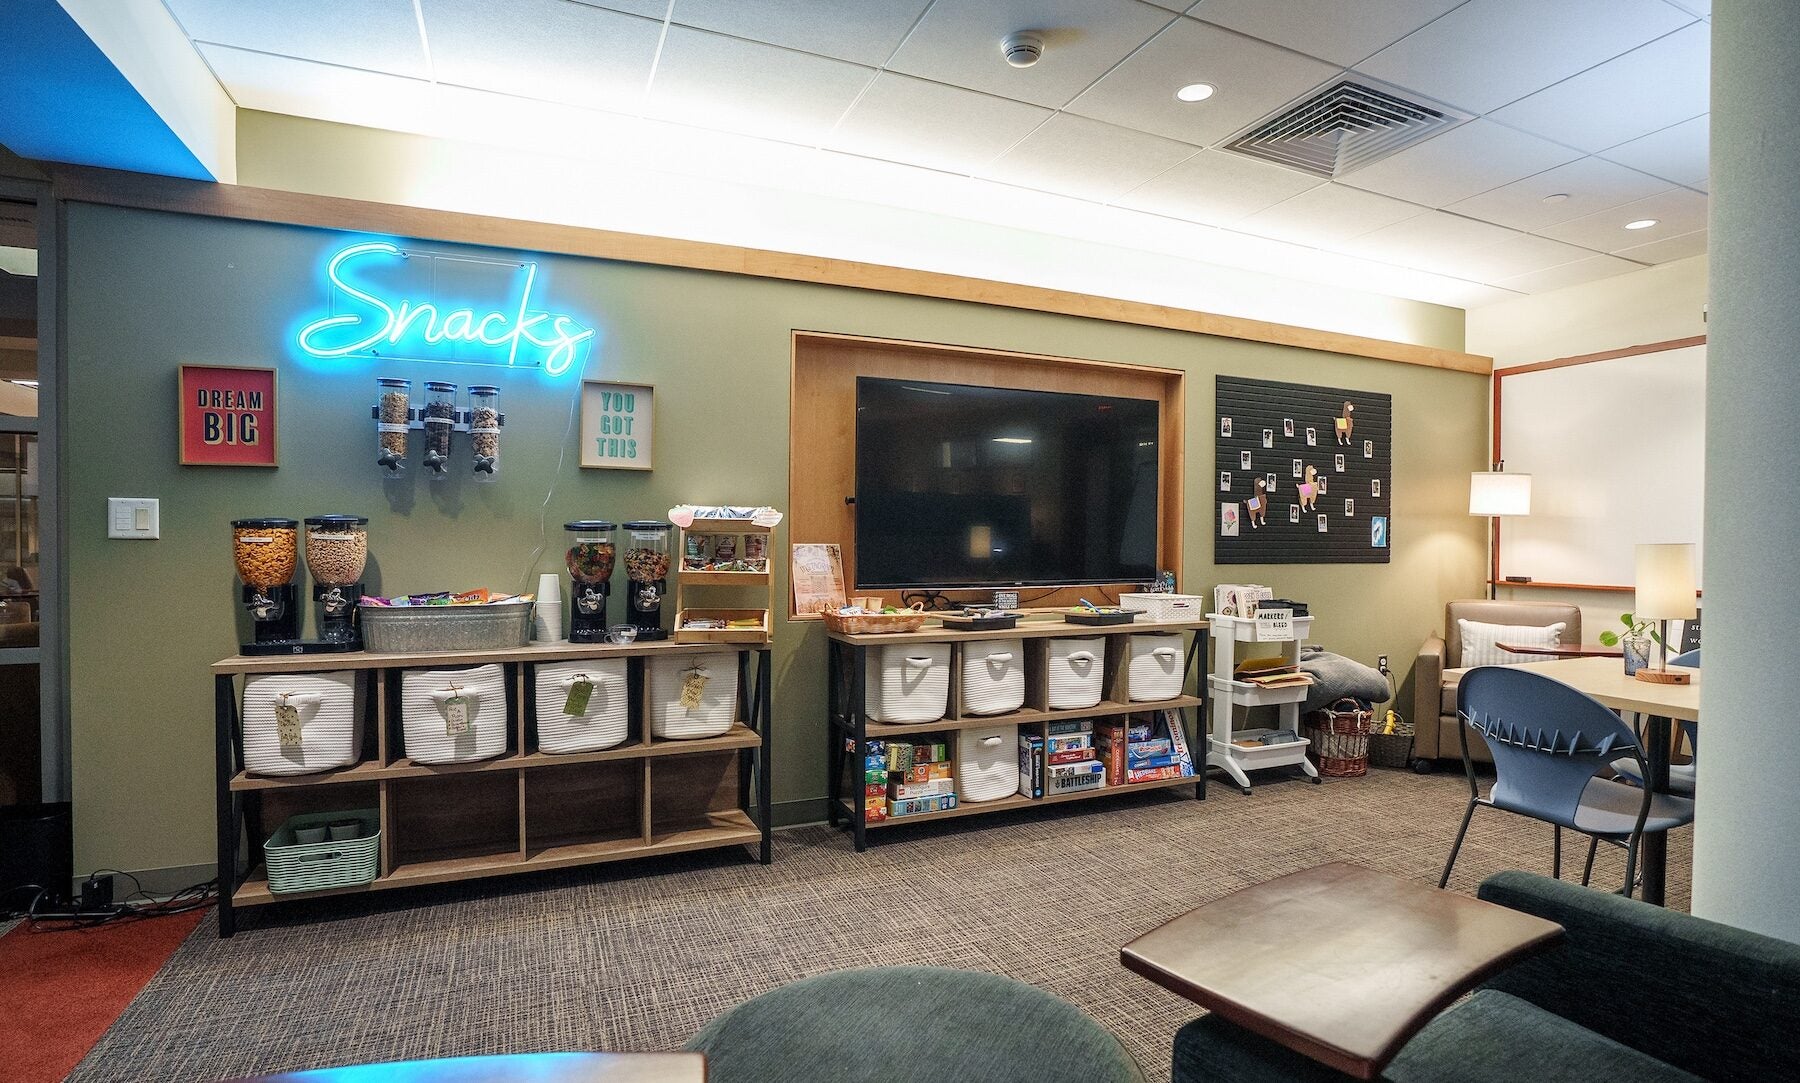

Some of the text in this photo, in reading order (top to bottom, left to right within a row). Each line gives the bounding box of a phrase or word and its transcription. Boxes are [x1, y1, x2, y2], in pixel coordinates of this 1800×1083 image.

[299, 242, 594, 375] Snacks
[198, 389, 263, 411] DREAM
[601, 391, 635, 413] YOU
[204, 411, 259, 446] BIG
[600, 414, 634, 436] GOT
[596, 437, 637, 459] THIS
[1060, 774, 1102, 789] BATTLESHIP
